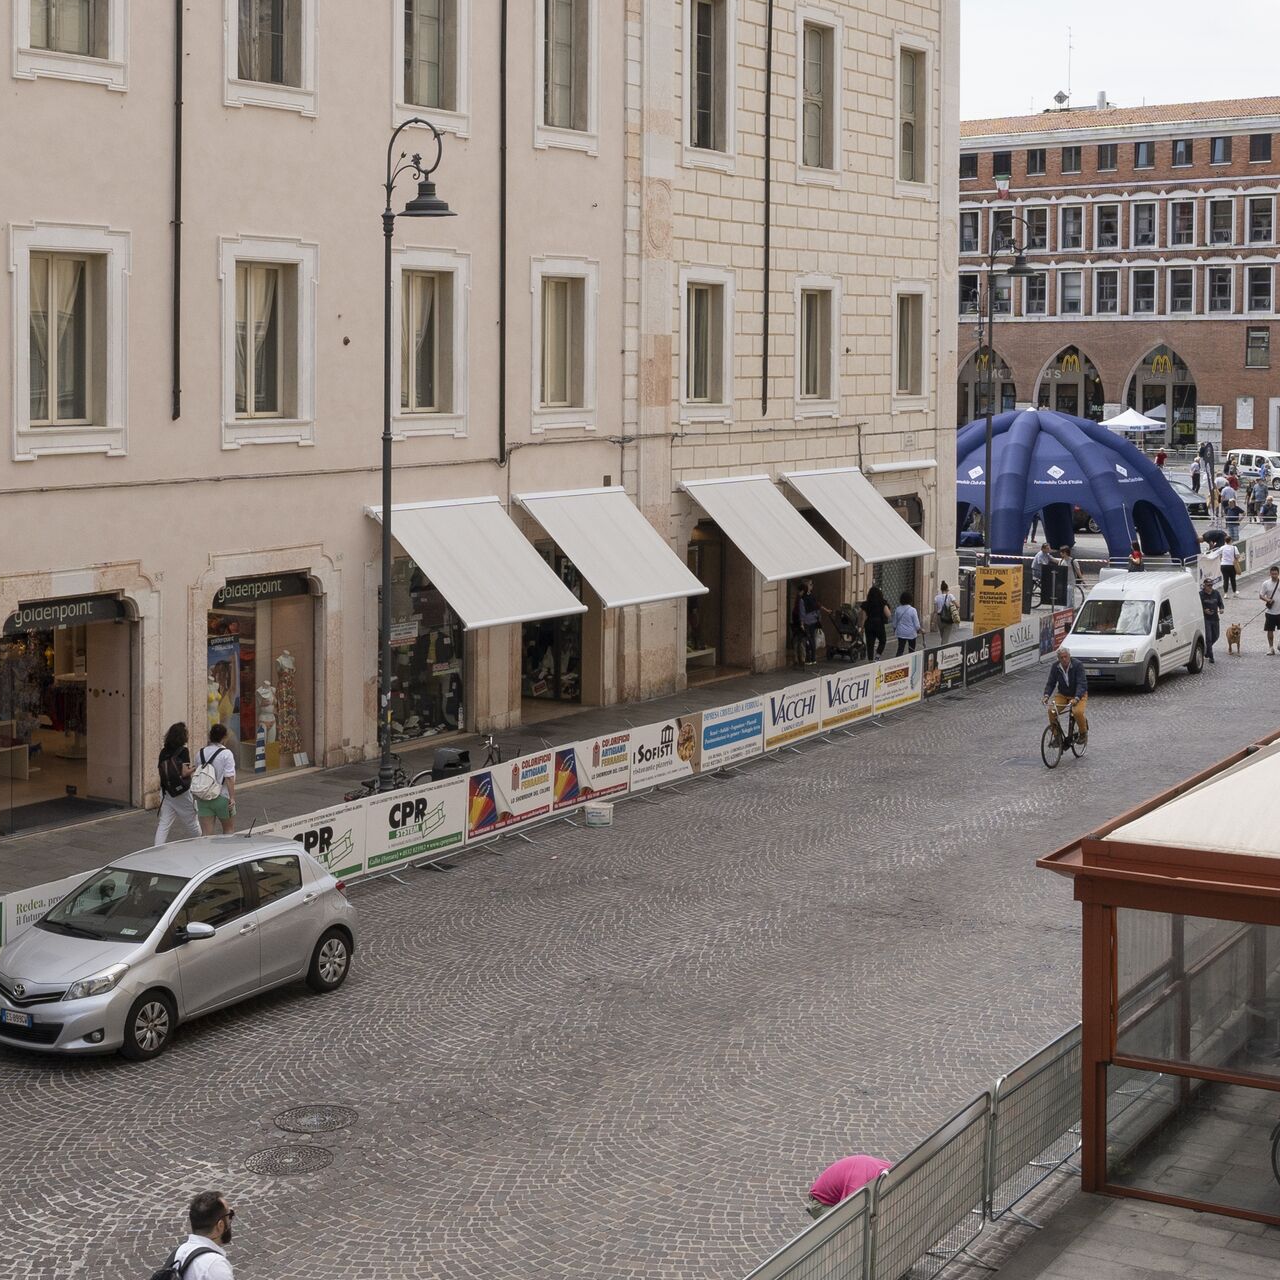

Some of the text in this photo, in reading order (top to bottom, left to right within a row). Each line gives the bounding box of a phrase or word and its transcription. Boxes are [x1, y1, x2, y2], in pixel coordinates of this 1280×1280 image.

[218, 579, 282, 603] goldenpoint
[14, 601, 94, 628] goldenpoint
[827, 677, 870, 708] VACCHI
[770, 694, 816, 726] VACCHI
[602, 734, 631, 748] COLORIFICIO
[601, 744, 627, 757] ARTIGIANO
[522, 753, 552, 769] COLORIFICIO
[601, 753, 628, 767] FERRARESE
[656, 759, 673, 770] pizzeria
[521, 764, 548, 780] ARTIGIANO
[521, 773, 550, 790] FERRARESE
[516, 792, 533, 802] SHOWROOM
[388, 797, 427, 829] CPR
[395, 825, 420, 838] SYSTEM
[16, 899, 46, 914] Redea.
[16, 917, 22, 926] il
